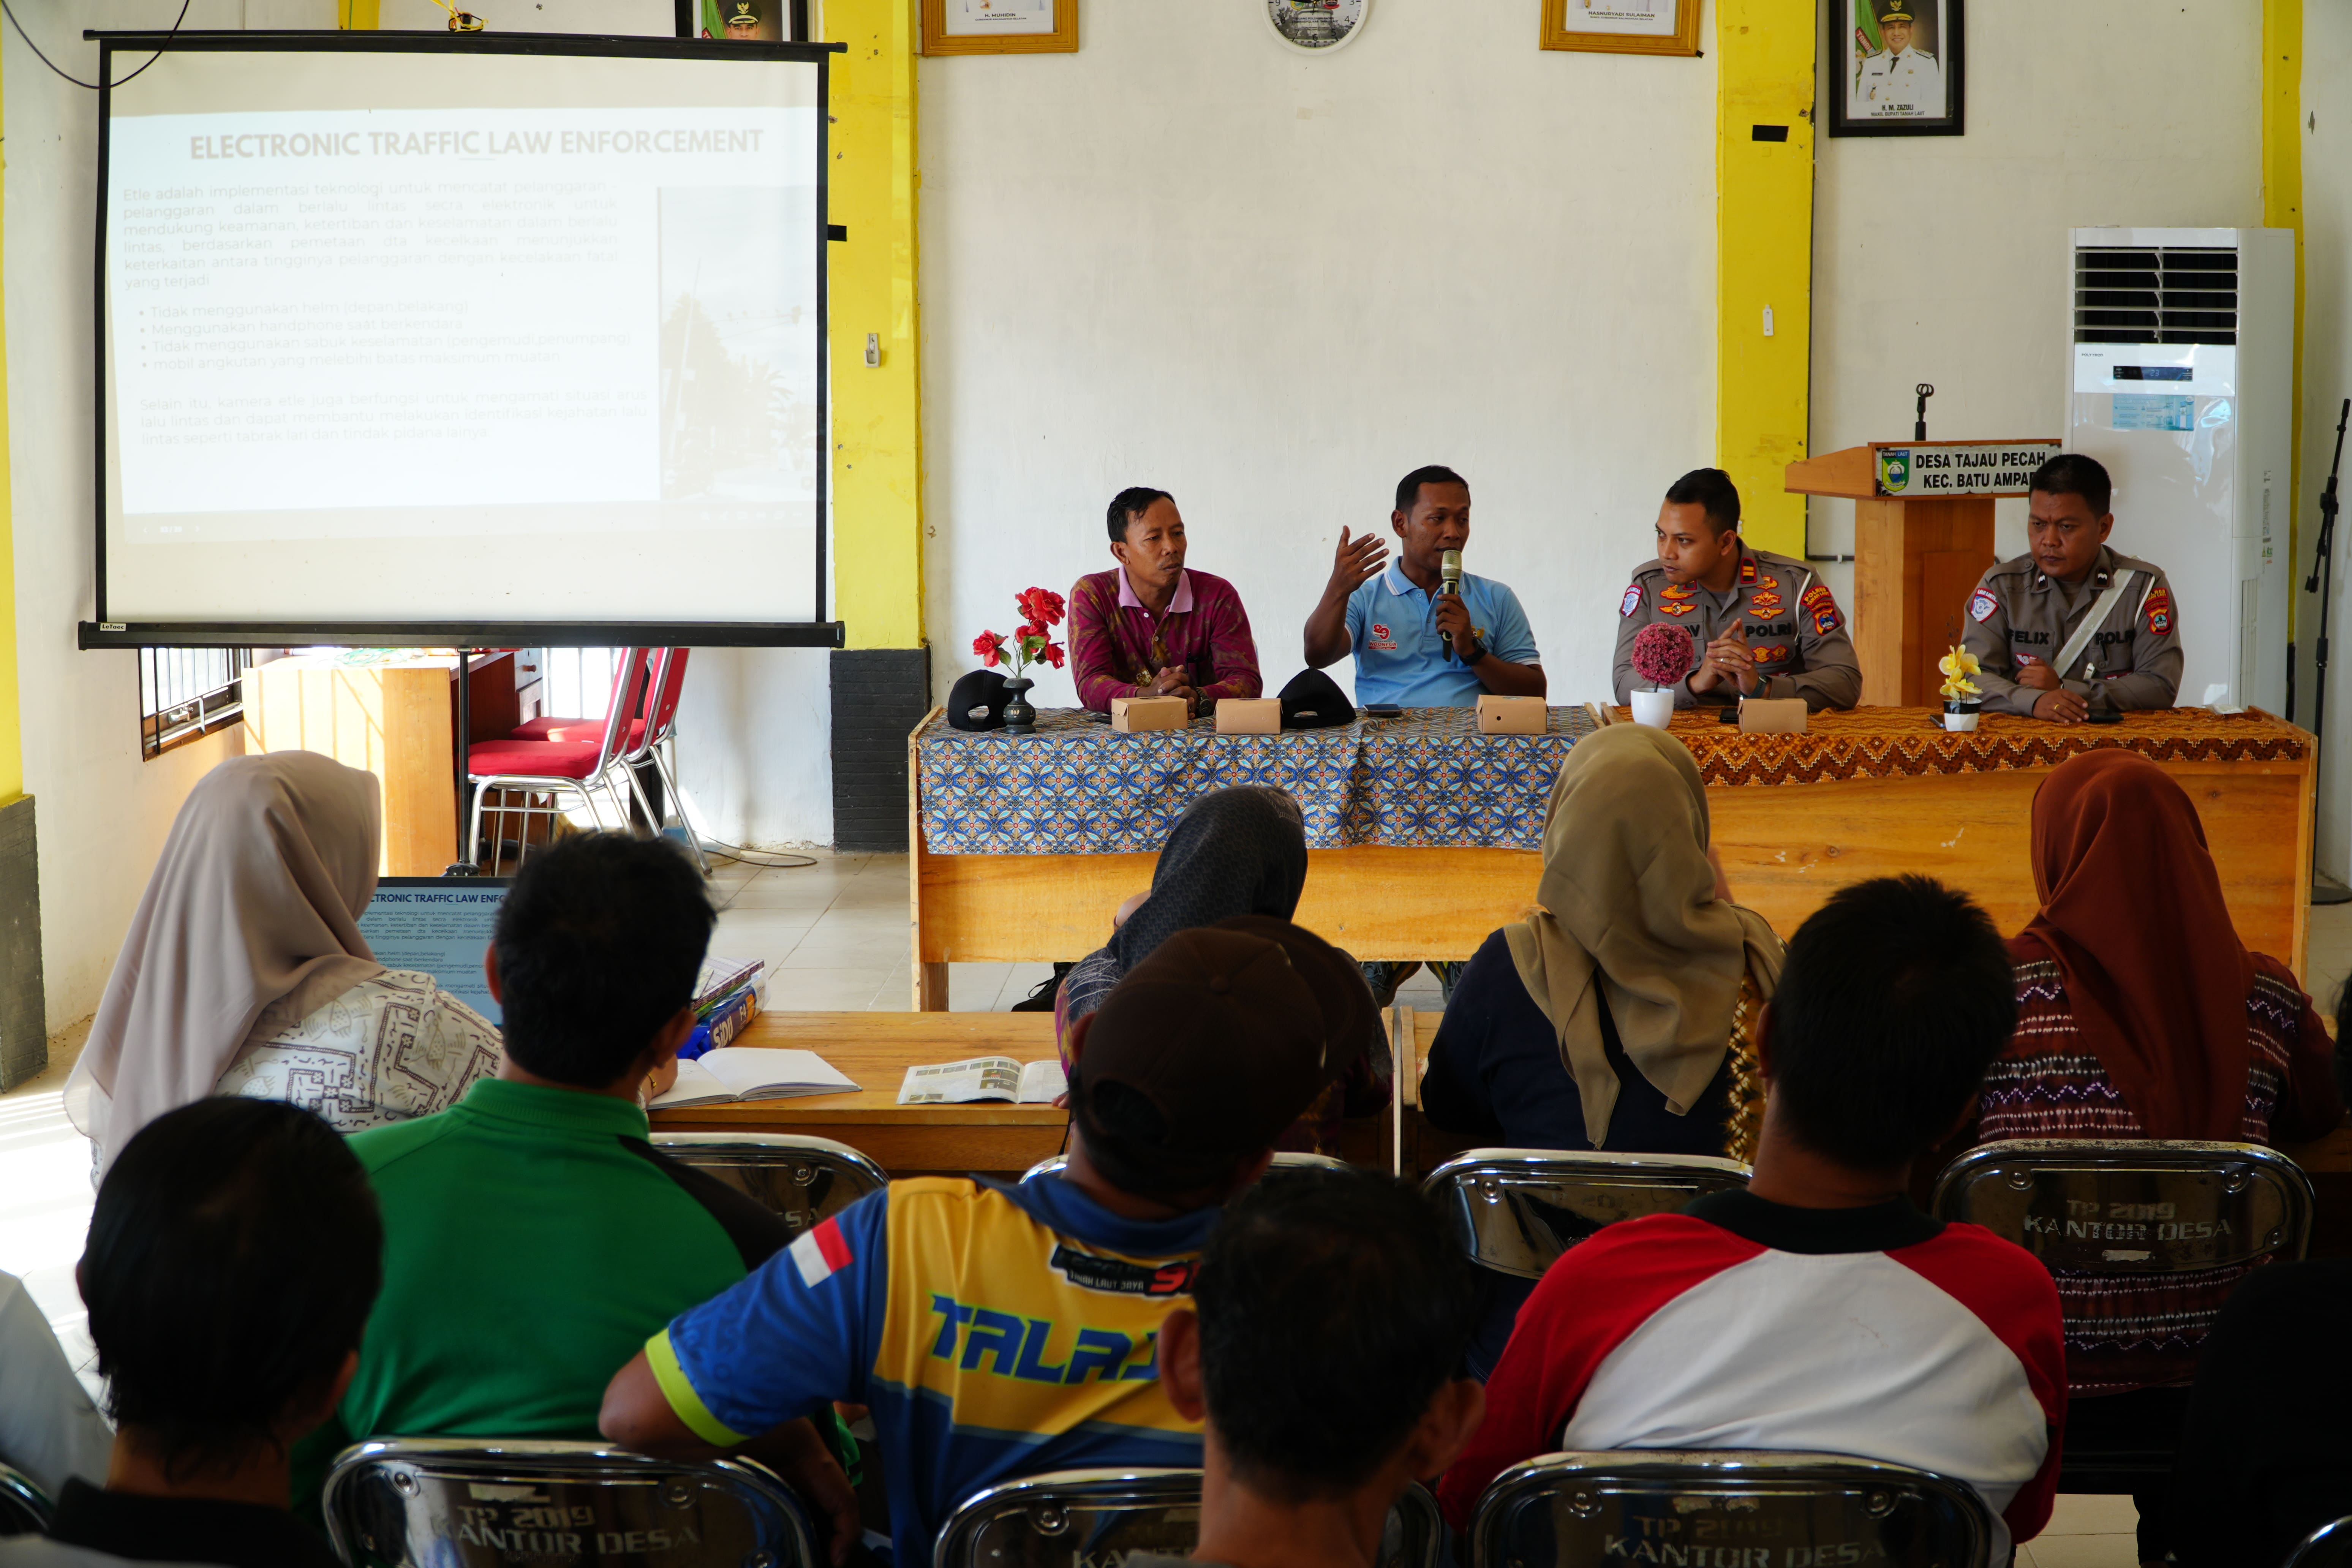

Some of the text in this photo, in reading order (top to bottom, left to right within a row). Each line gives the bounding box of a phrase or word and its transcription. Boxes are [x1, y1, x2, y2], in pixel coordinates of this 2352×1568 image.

[191, 130, 763, 160] ELECTRONIC TRAFFIC LAW ENFORCEMENT
[123, 181, 606, 201] Etle adalah implementasi teknologi untuk mencatat pelanggaran
[123, 198, 617, 221] pelanggaran dalam berlalu lintas secra elektronik untuk
[124, 222, 213, 236] mendukung
[305, 218, 379, 229] ketertiban
[385, 218, 413, 229] dan
[419, 217, 511, 228] keselamatan
[517, 217, 562, 228] dalam
[568, 215, 617, 227] berlalu
[183, 238, 272, 251] berdasarkan
[291, 237, 365, 250] pemetaan
[383, 236, 407, 247] dta
[426, 234, 498, 246] kecelkaan
[517, 233, 618, 248] menunjukkan
[125, 250, 618, 270] keterkaitan antara tingginya pelanggaran dengan kecelakaan fatal
[125, 273, 209, 291] yang terjadi
[151, 305, 188, 317] Tidak
[192, 302, 298, 318] menggunakan
[302, 302, 339, 313] helm
[152, 318, 463, 337] Menggunakan handphone saat berkendara
[153, 340, 189, 352] Tidak
[194, 338, 300, 353] menggunakan
[304, 336, 346, 348] sabuk
[351, 335, 443, 347] keselamatan
[154, 352, 560, 371] mobil angkutan yang melebihi batas maksimum muatan
[140, 398, 182, 411] Selain
[218, 396, 272, 408] kamera
[278, 394, 305, 406] etle
[310, 394, 343, 408] juga
[349, 392, 419, 407] berfungsi
[426, 392, 469, 404] untuk
[475, 389, 559, 405] mengamati
[565, 389, 610, 401] situasi
[616, 391, 647, 401] arus
[141, 405, 647, 428] lalu lintas dan dapat membantu melakukan identifikasi kejahatan lalu
[142, 433, 180, 444] lintas
[183, 431, 232, 445] seperti
[236, 430, 282, 442] tabrak
[287, 428, 307, 441] lari
[311, 428, 339, 440] dan
[343, 427, 389, 439] tindak
[394, 427, 443, 441] pidana
[1916, 452, 2046, 469] DESA TAJAU PECAH
[1924, 474, 1952, 488] KEC.
[1957, 473, 1990, 488] BATU
[1745, 623, 1792, 637] POLRI
[2009, 628, 2050, 645] FELIX
[371, 894, 412, 903] TRONIC
[415, 894, 454, 903] TRAFFIC
[456, 895, 479, 903] LAW
[739, 1003, 747, 1021] F4
[2066, 1199, 2100, 1216] TP
[2023, 1215, 2233, 1241] KANTOR DESA
[457, 1505, 596, 1529] TP 2019
[1633, 1516, 1681, 1537] TP
[432, 1517, 700, 1554] KANTOR DESA
[1604, 1533, 1886, 1568] KANTOR DESA
